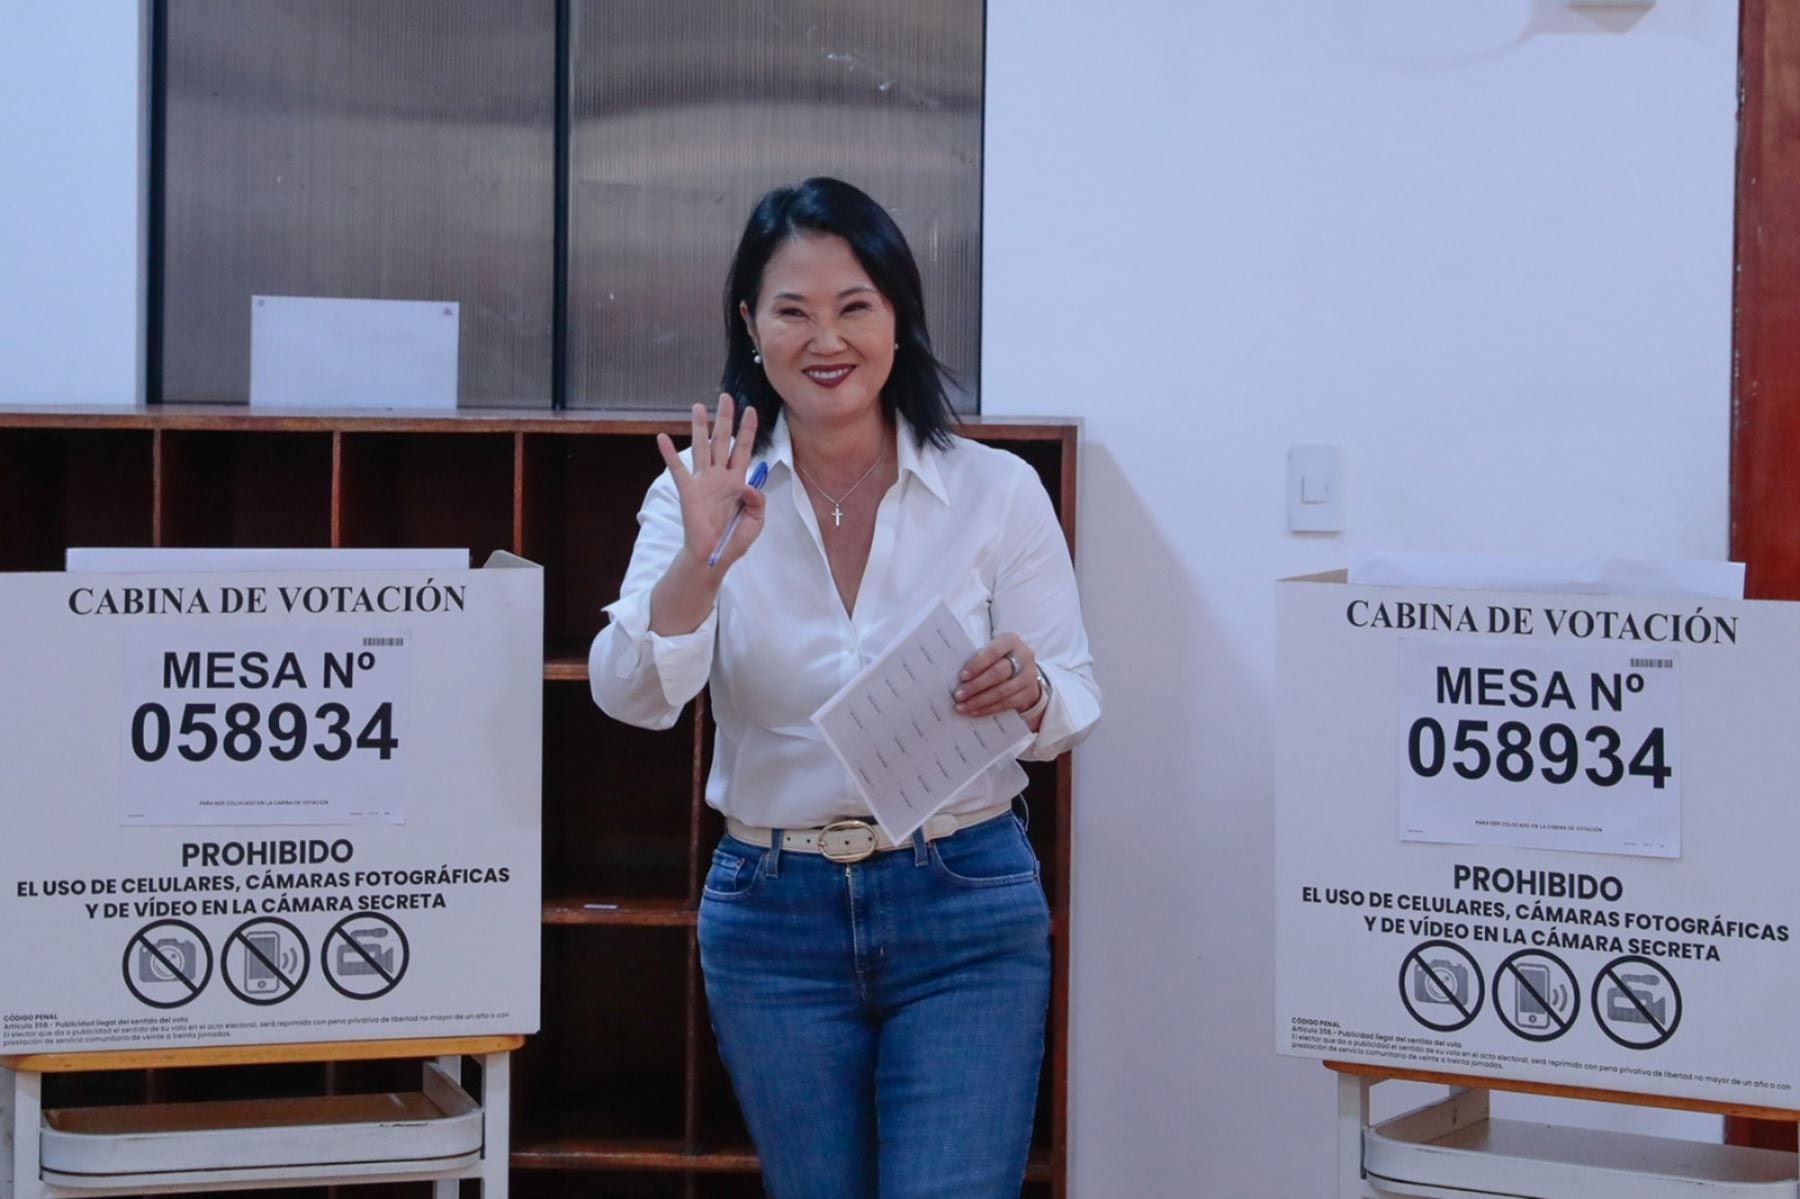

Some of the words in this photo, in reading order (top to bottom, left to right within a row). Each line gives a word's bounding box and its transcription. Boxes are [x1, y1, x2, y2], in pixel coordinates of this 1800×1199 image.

[68, 587, 210, 615] CABINA
[221, 587, 267, 614] DE
[278, 577, 466, 613] VOTACIÓN
[1346, 600, 1479, 633] CABINA
[1487, 606, 1533, 635] DE
[1544, 606, 1738, 644] VOTACIÓN
[163, 651, 308, 690] MESA
[323, 651, 376, 689] Nº
[1436, 666, 1577, 710] MESA
[1590, 672, 1645, 712] Nº
[131, 702, 399, 763] 058934
[1408, 716, 1672, 789] 058934
[182, 838, 354, 868] PROHIBIDO
[17, 881, 39, 897] EL
[43, 879, 87, 897] USO
[91, 878, 117, 895] DE
[121, 875, 241, 894] CELULARES,
[245, 869, 351, 894] CÁMARAS
[354, 864, 510, 887] FOTOGRÁFICAS
[1454, 864, 1623, 902] PROHIBIDO
[85, 903, 99, 919] Y
[103, 902, 130, 919] DE
[133, 896, 198, 920] VÍDEO
[202, 899, 228, 916] EN
[232, 898, 257, 915] LA
[261, 892, 353, 914] CÁMARA
[357, 892, 447, 912] SECRETA
[1302, 886, 1322, 903] EL
[1325, 888, 1365, 907] USO
[1369, 891, 1393, 909] DE
[1397, 894, 1511, 921] CELULARES,
[1515, 899, 1620, 928] CÁMARAS
[1624, 912, 1790, 942] FOTOGRÁFICAS
[1363, 915, 1377, 932] Y
[1381, 917, 1405, 935] DE
[1408, 915, 1469, 945] VÍDEO
[1473, 924, 1499, 944] EN
[1502, 926, 1528, 947] LA
[1531, 925, 1624, 954] CÁMARA
[1627, 938, 1721, 963] SECRETA
[35, 1013, 57, 1021] PENAL
[1291, 1016, 1318, 1026] CÓDIGO
[1320, 1019, 1340, 1028] PENAL
